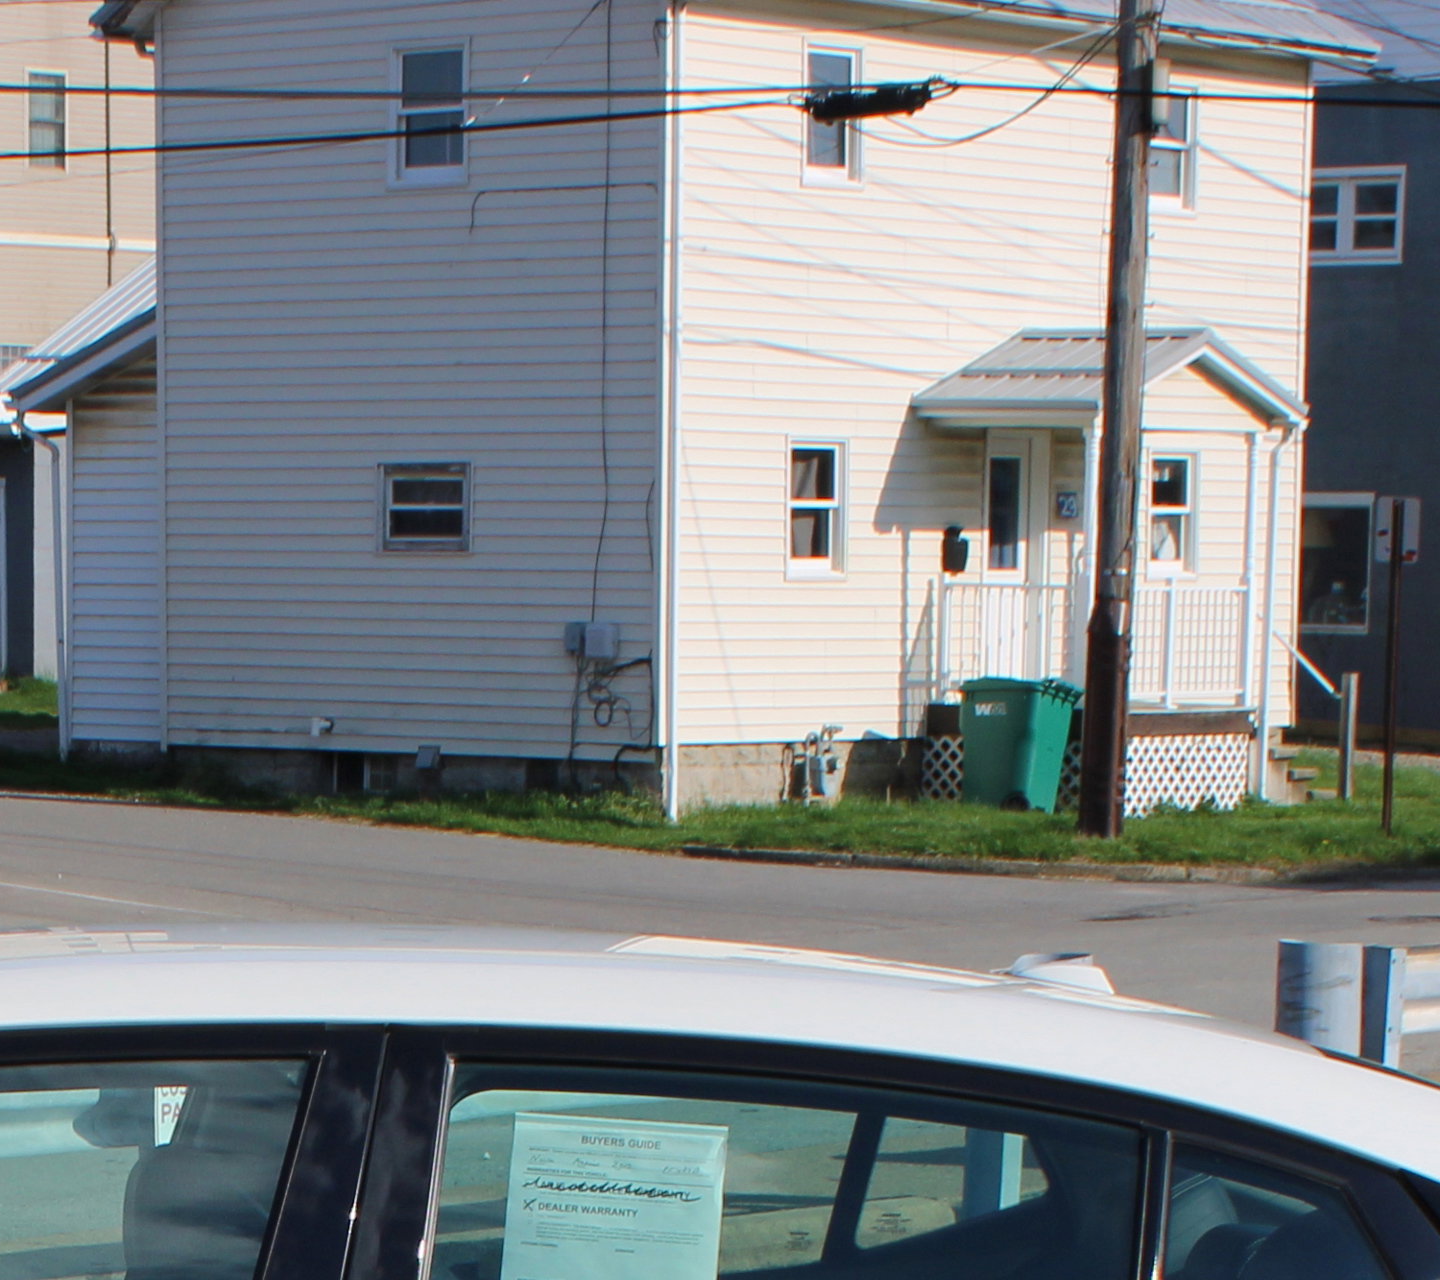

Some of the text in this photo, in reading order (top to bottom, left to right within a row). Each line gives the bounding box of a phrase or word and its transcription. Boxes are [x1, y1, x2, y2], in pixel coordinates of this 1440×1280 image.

[580, 1135, 662, 1150] BUYERS GUIDE
[538, 1202, 639, 1218] DEALER WARRANTY
